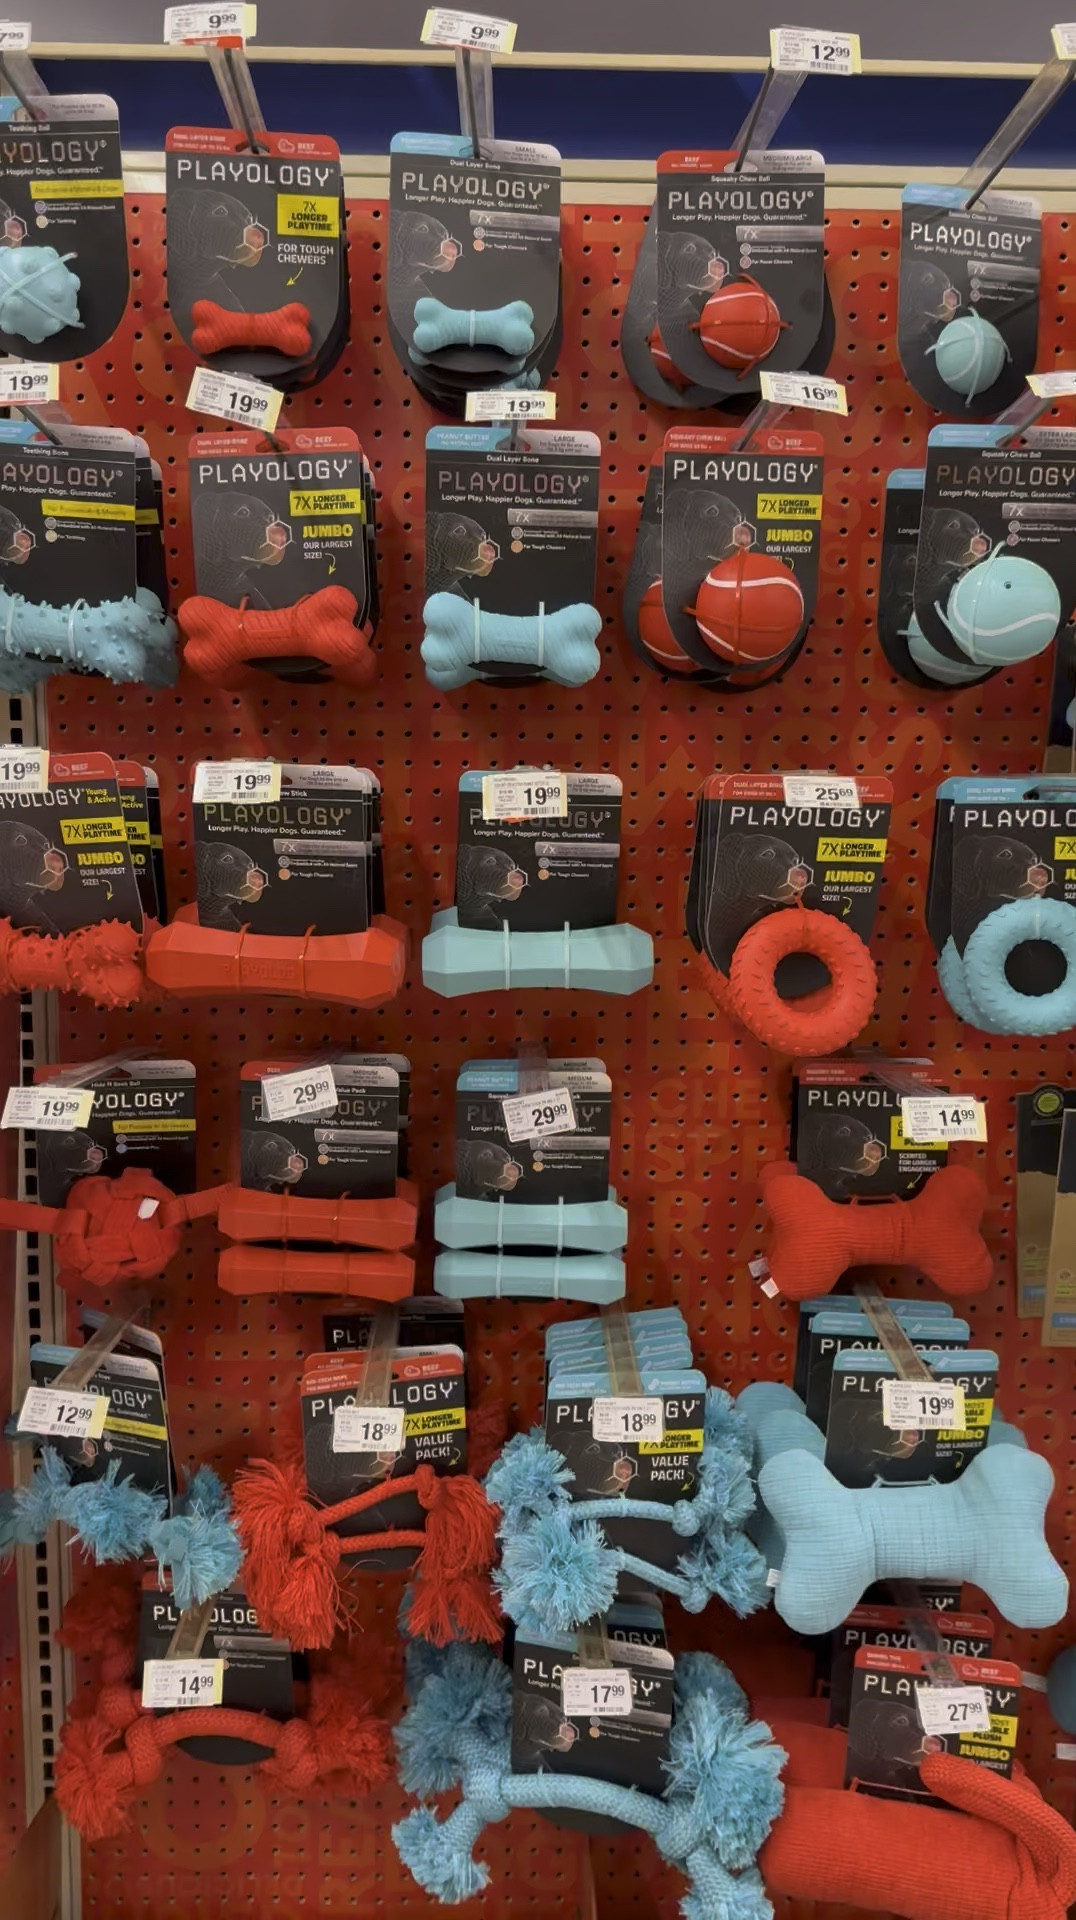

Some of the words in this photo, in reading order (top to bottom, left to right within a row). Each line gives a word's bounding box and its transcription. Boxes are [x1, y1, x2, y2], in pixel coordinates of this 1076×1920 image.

[8, 124, 37, 132] Teething
[450, 159, 464, 167] Dual
[466, 160, 484, 169] Layer
[6, 168, 34, 177] Happier
[35, 168, 55, 176] Dogs.
[711, 175, 738, 183] Squeaky
[405, 193, 429, 203] Longer
[430, 195, 446, 204] Play.
[448, 197, 475, 206] Happier
[476, 199, 496, 207] Dogs.
[303, 201, 317, 212] 7X
[291, 213, 328, 222] LONGER
[672, 214, 696, 223] Longer
[715, 214, 742, 222] Happier
[287, 221, 332, 231] PLAYTIME
[278, 243, 297, 253] FOR
[300, 244, 334, 255] TOUGH
[278, 254, 327, 265] CHEWERS
[23, 447, 50, 456] Teething
[981, 451, 1008, 459] Squeaky
[1010, 451, 1028, 459] Chew
[503, 455, 522, 464] Layer
[19, 486, 47, 495] Happier
[48, 487, 69, 496] Dogs.
[964, 490, 980, 498] Play.
[981, 490, 1009, 498] Happier
[1010, 490, 1028, 498] Dogs.
[293, 495, 311, 510] 7X
[313, 494, 347, 503] LONGER
[441, 493, 466, 503] Longer
[467, 494, 483, 503] Play.
[485, 495, 513, 504] Happier
[515, 496, 533, 505] Dogs.
[313, 501, 356, 510] PLAYTIME
[761, 500, 777, 513] 7X
[778, 507, 817, 515] PLAYTIME
[303, 524, 353, 539] JUMBO
[766, 529, 813, 542] JUMBO
[303, 541, 320, 549] OUR
[321, 540, 353, 548] LARGEST
[766, 545, 781, 553] OUR
[782, 545, 812, 553] LARGEST
[303, 552, 323, 560] SIZE!
[86, 788, 108, 796] Young
[121, 801, 144, 809] Active
[964, 809, 1076, 828] PLAYOLO
[64, 825, 82, 839] 7X
[82, 822, 113, 830] LONGER
[83, 830, 122, 839] PLAYTIME
[208, 825, 232, 833] Longer
[233, 826, 249, 834] Play.
[251, 827, 278, 835] Happier
[280, 827, 299, 835] Dogs.
[474, 829, 496, 837] Longer
[498, 830, 514, 838] Play.
[514, 830, 540, 838] Happier
[542, 831, 560, 839] Dogs.
[822, 843, 840, 856] 7X
[1059, 841, 1076, 854] 7X
[77, 852, 124, 866] JUMBO
[839, 850, 882, 858] PLAYTIME
[96, 867, 126, 876] LARGEST
[824, 870, 875, 883] JUMBO
[808, 1090, 901, 1108] PLAYOL
[405, 1418, 420, 1431] 7X
[422, 1413, 453, 1422] LONGER
[422, 1419, 461, 1429] PLAYTIME
[414, 1433, 453, 1447] VALUE
[936, 1430, 984, 1441] JUMBO
[415, 1447, 451, 1461] PACK!
[651, 1455, 689, 1466] VALUE
[651, 1469, 685, 1481] PACK!
[973, 1733, 1001, 1741] PLUSH
[959, 1745, 1009, 1760] JUMBO
